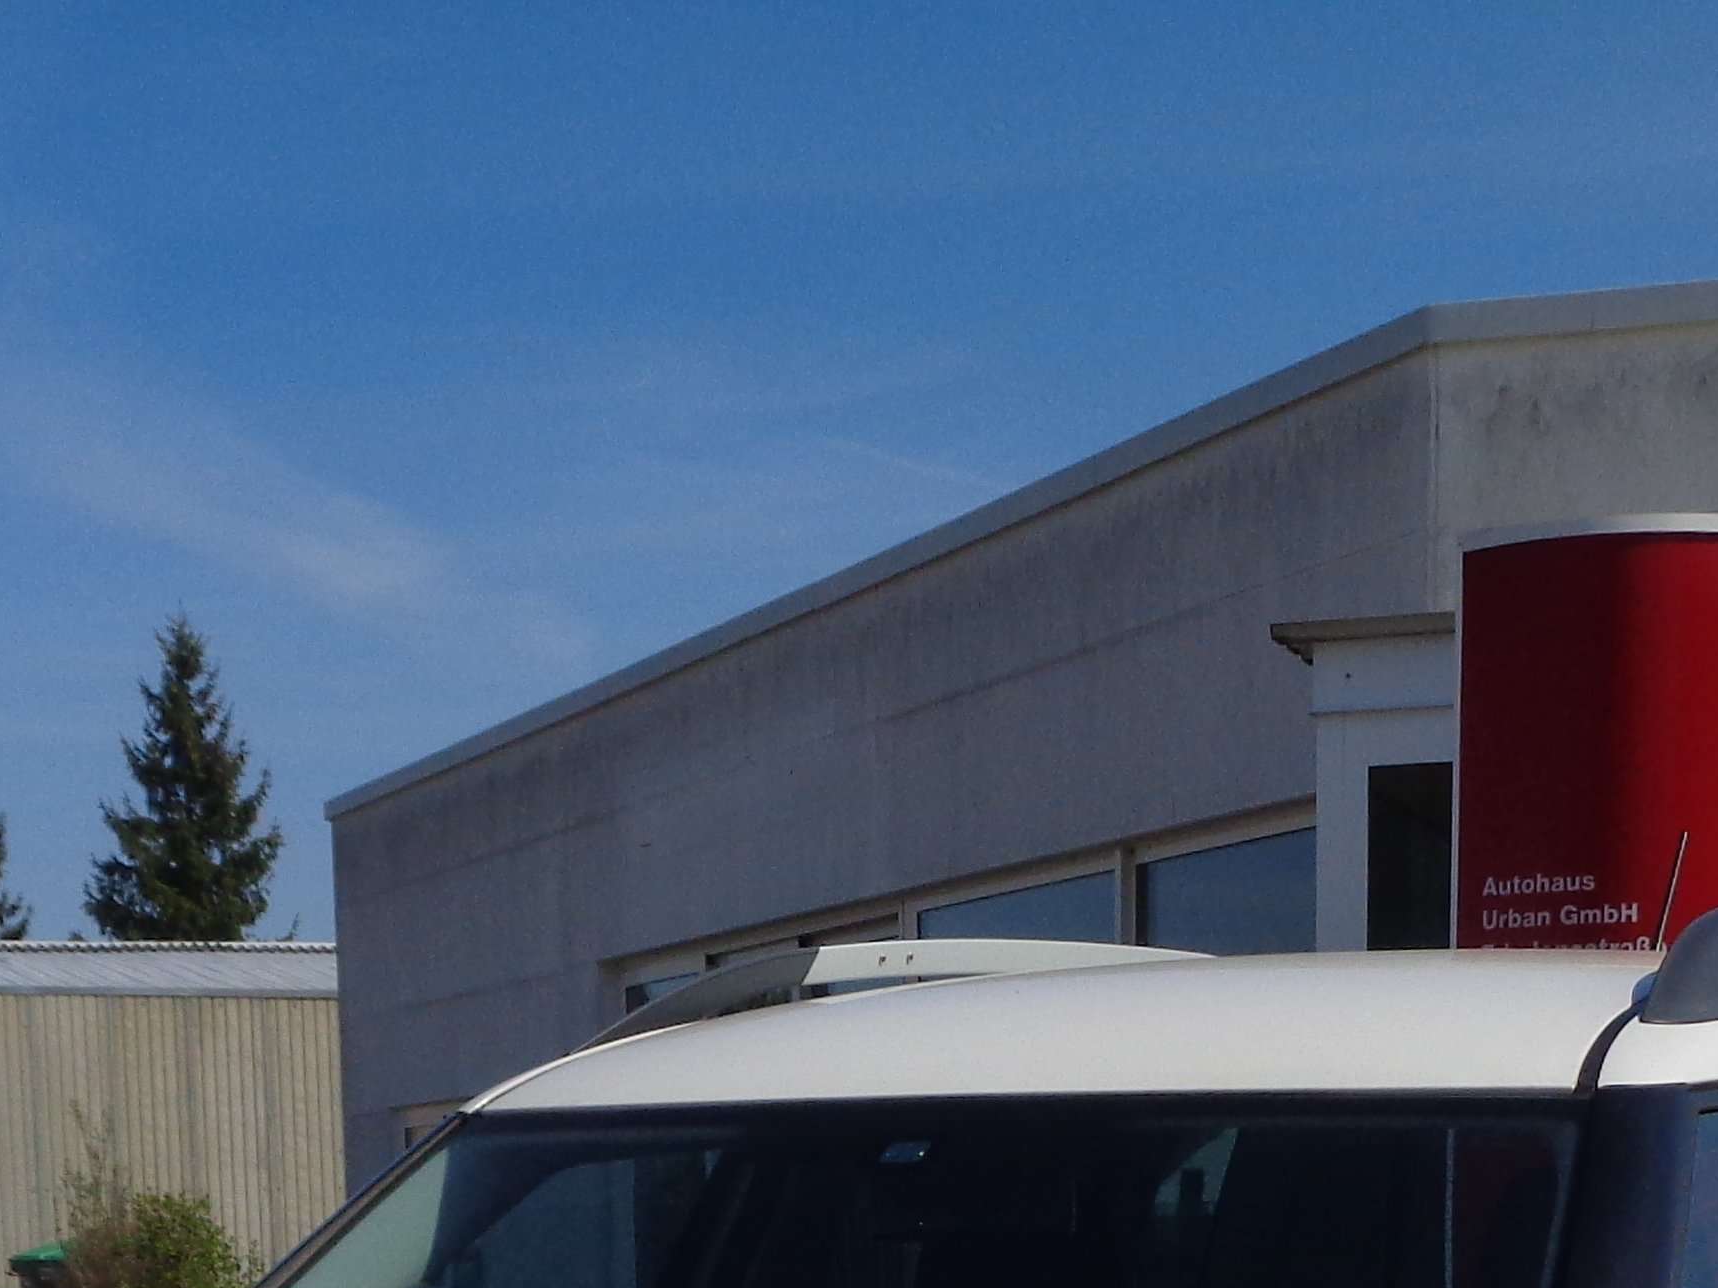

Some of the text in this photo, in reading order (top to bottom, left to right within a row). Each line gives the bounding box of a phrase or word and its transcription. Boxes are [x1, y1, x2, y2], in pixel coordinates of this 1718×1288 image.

[1483, 874, 1595, 896] Autohaus
[1483, 903, 1638, 929] Urban GmbH
